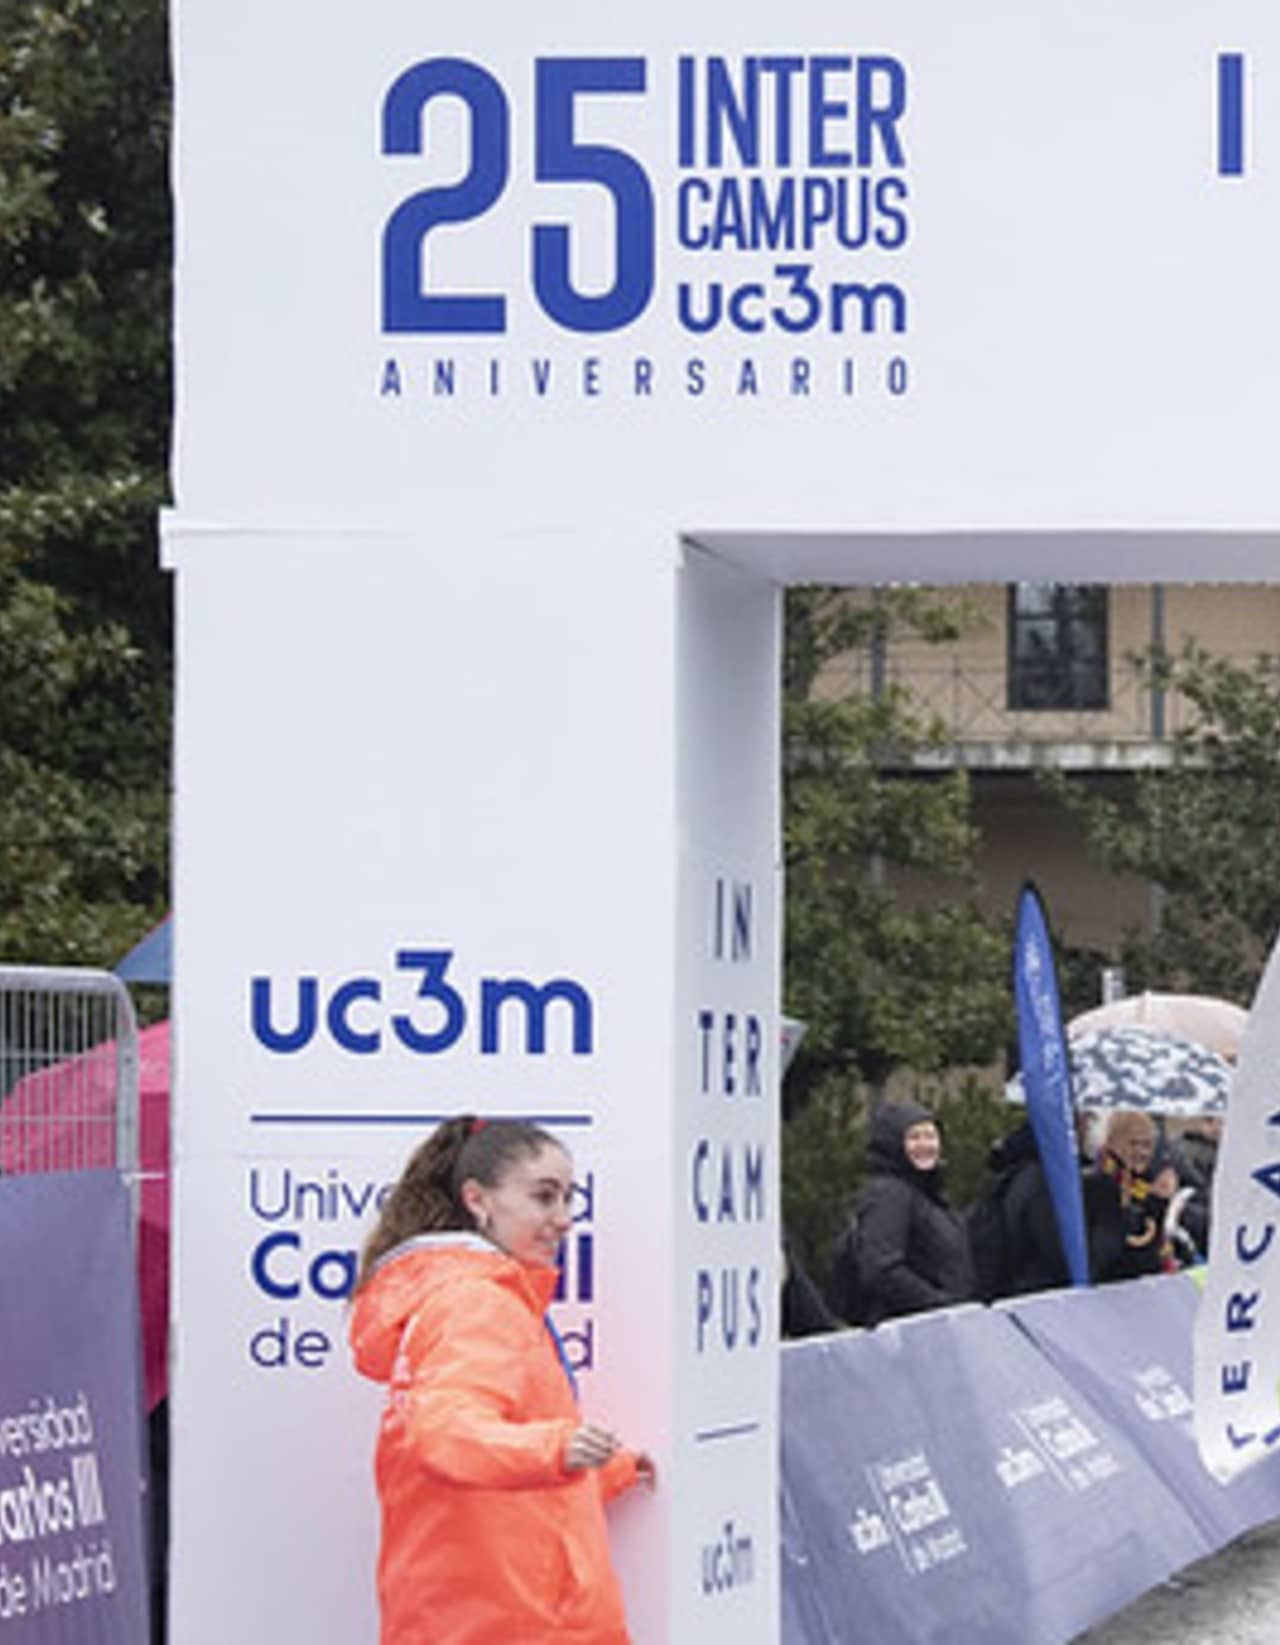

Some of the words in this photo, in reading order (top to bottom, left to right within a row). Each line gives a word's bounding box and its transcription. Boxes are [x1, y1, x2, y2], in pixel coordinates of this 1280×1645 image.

[676, 52, 909, 172] INTER
[378, 53, 658, 338] 25
[675, 173, 911, 253] CAMPUS
[674, 262, 909, 337] uc3m
[380, 356, 909, 398] ANIVERSARIO
[714, 876, 755, 961] IN
[249, 947, 595, 1058] uc3m
[697, 1008, 764, 1098] TER
[692, 1135, 766, 1225] CAM
[249, 1315, 332, 1368] de
[695, 1264, 762, 1354] PUS
[0, 1463, 74, 1545] arlos
